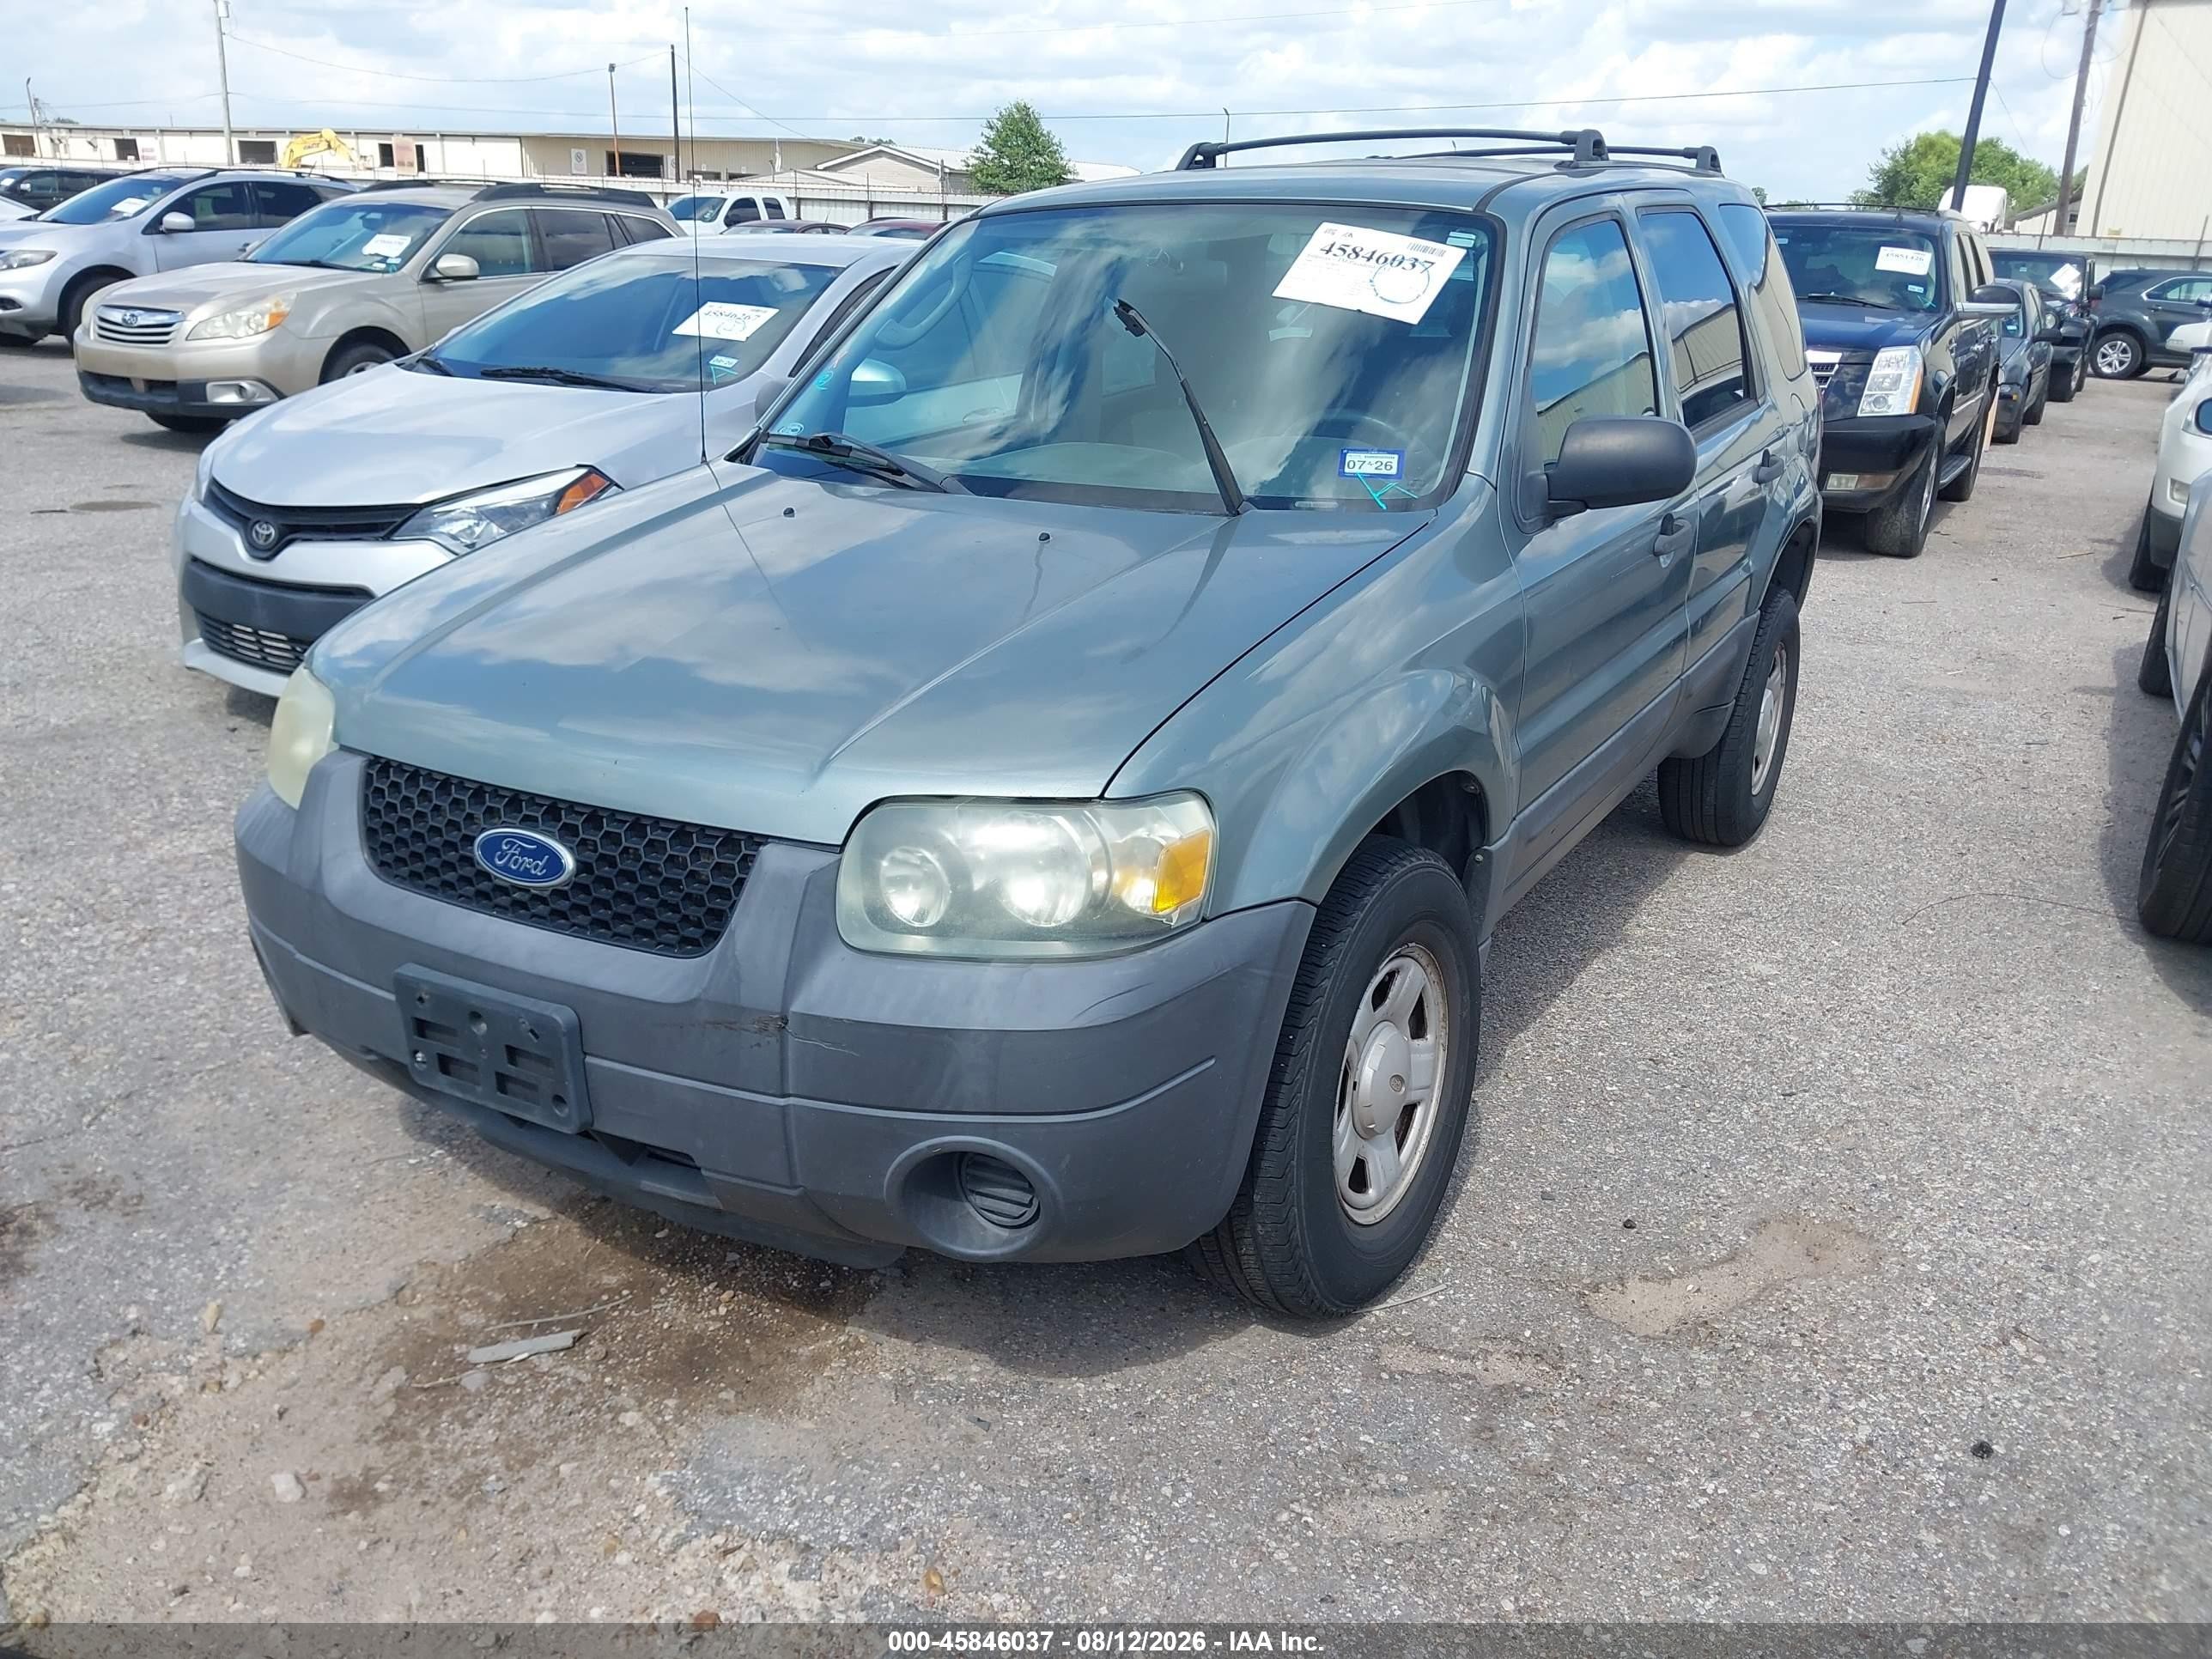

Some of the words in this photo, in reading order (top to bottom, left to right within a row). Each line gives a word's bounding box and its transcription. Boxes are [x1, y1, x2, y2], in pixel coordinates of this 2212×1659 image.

[1320, 241, 1436, 274] 45846037
[1346, 459, 1366, 471] 07
[1374, 460, 1394, 471] 26
[495, 837, 550, 876] Ford
